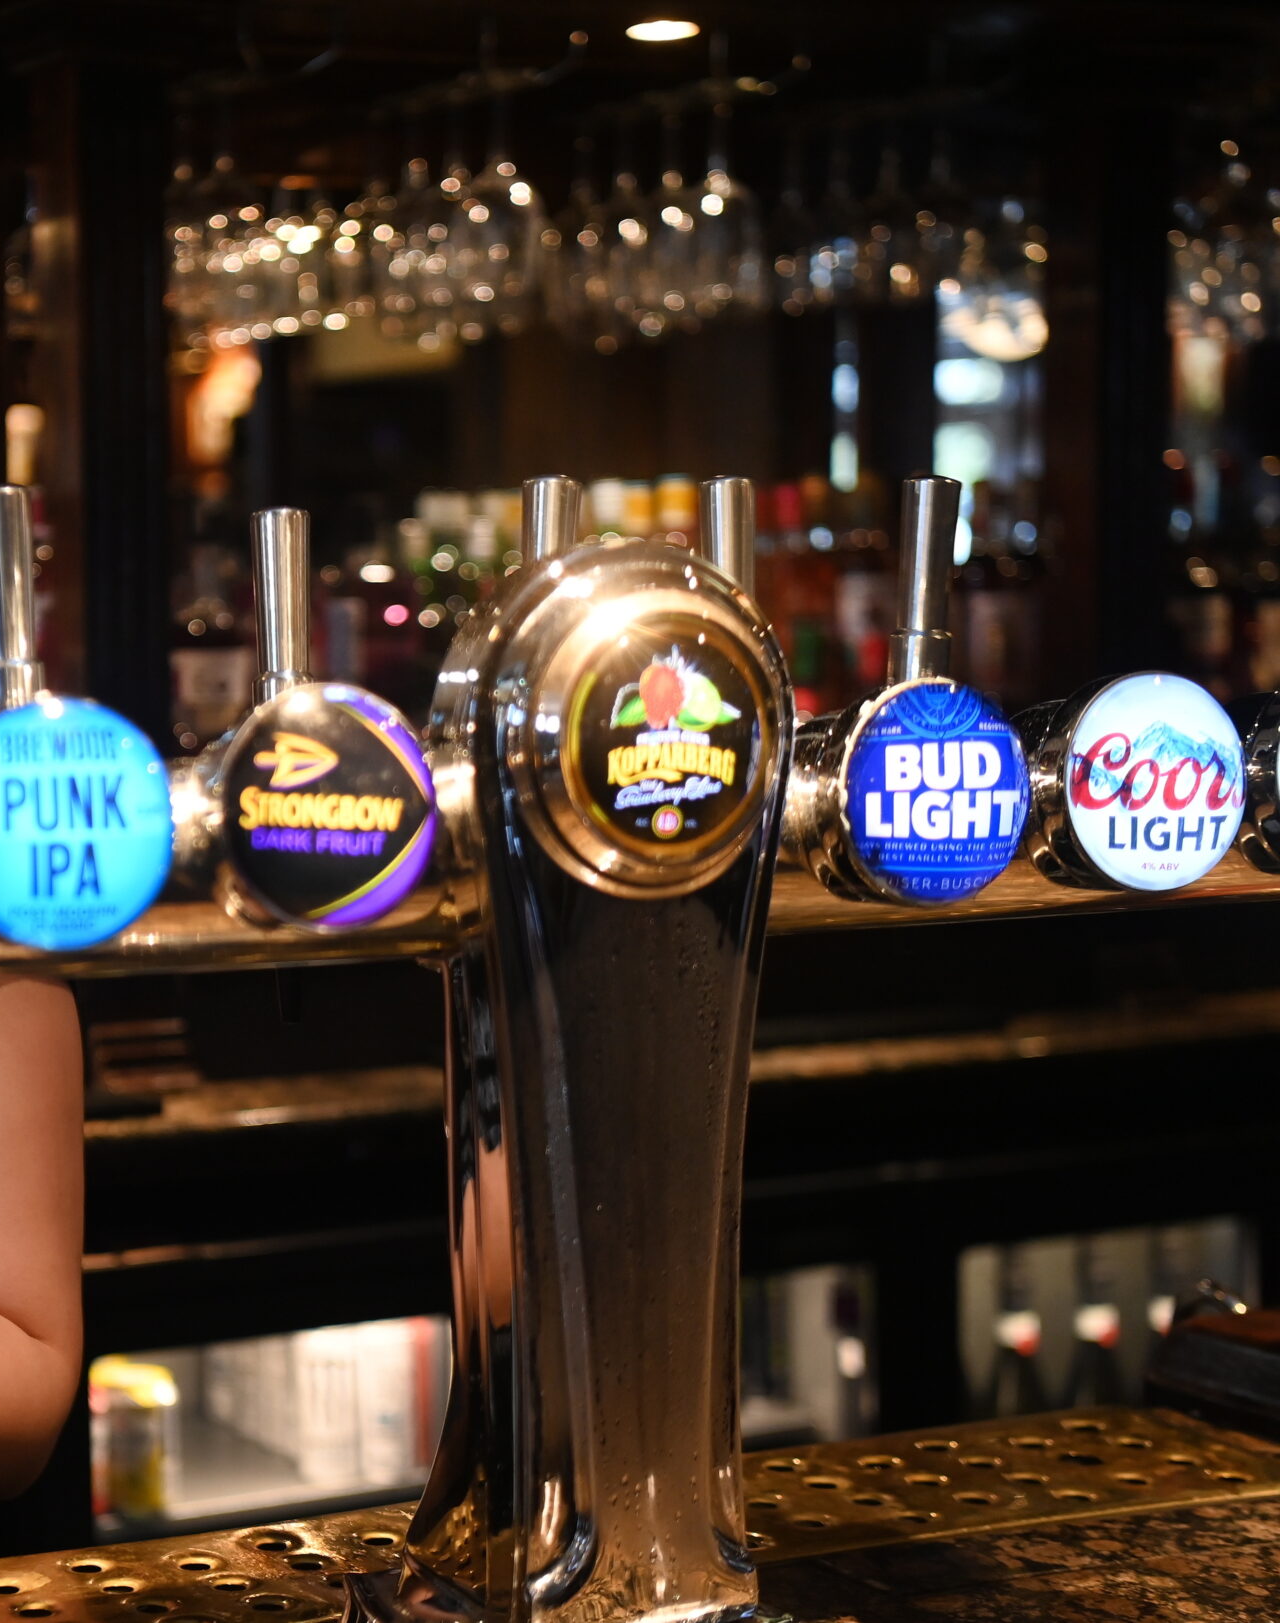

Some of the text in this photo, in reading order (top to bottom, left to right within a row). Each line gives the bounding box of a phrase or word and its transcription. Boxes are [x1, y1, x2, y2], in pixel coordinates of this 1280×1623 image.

[885, 741, 1001, 792] BUD
[4, 774, 127, 831] PUNK
[239, 786, 404, 831] STRONGBOW
[865, 790, 1021, 839] LIGHT
[251, 827, 387, 856] DARK FRUIT
[1108, 816, 1228, 852] LIGHT
[30, 841, 101, 897] IPA
